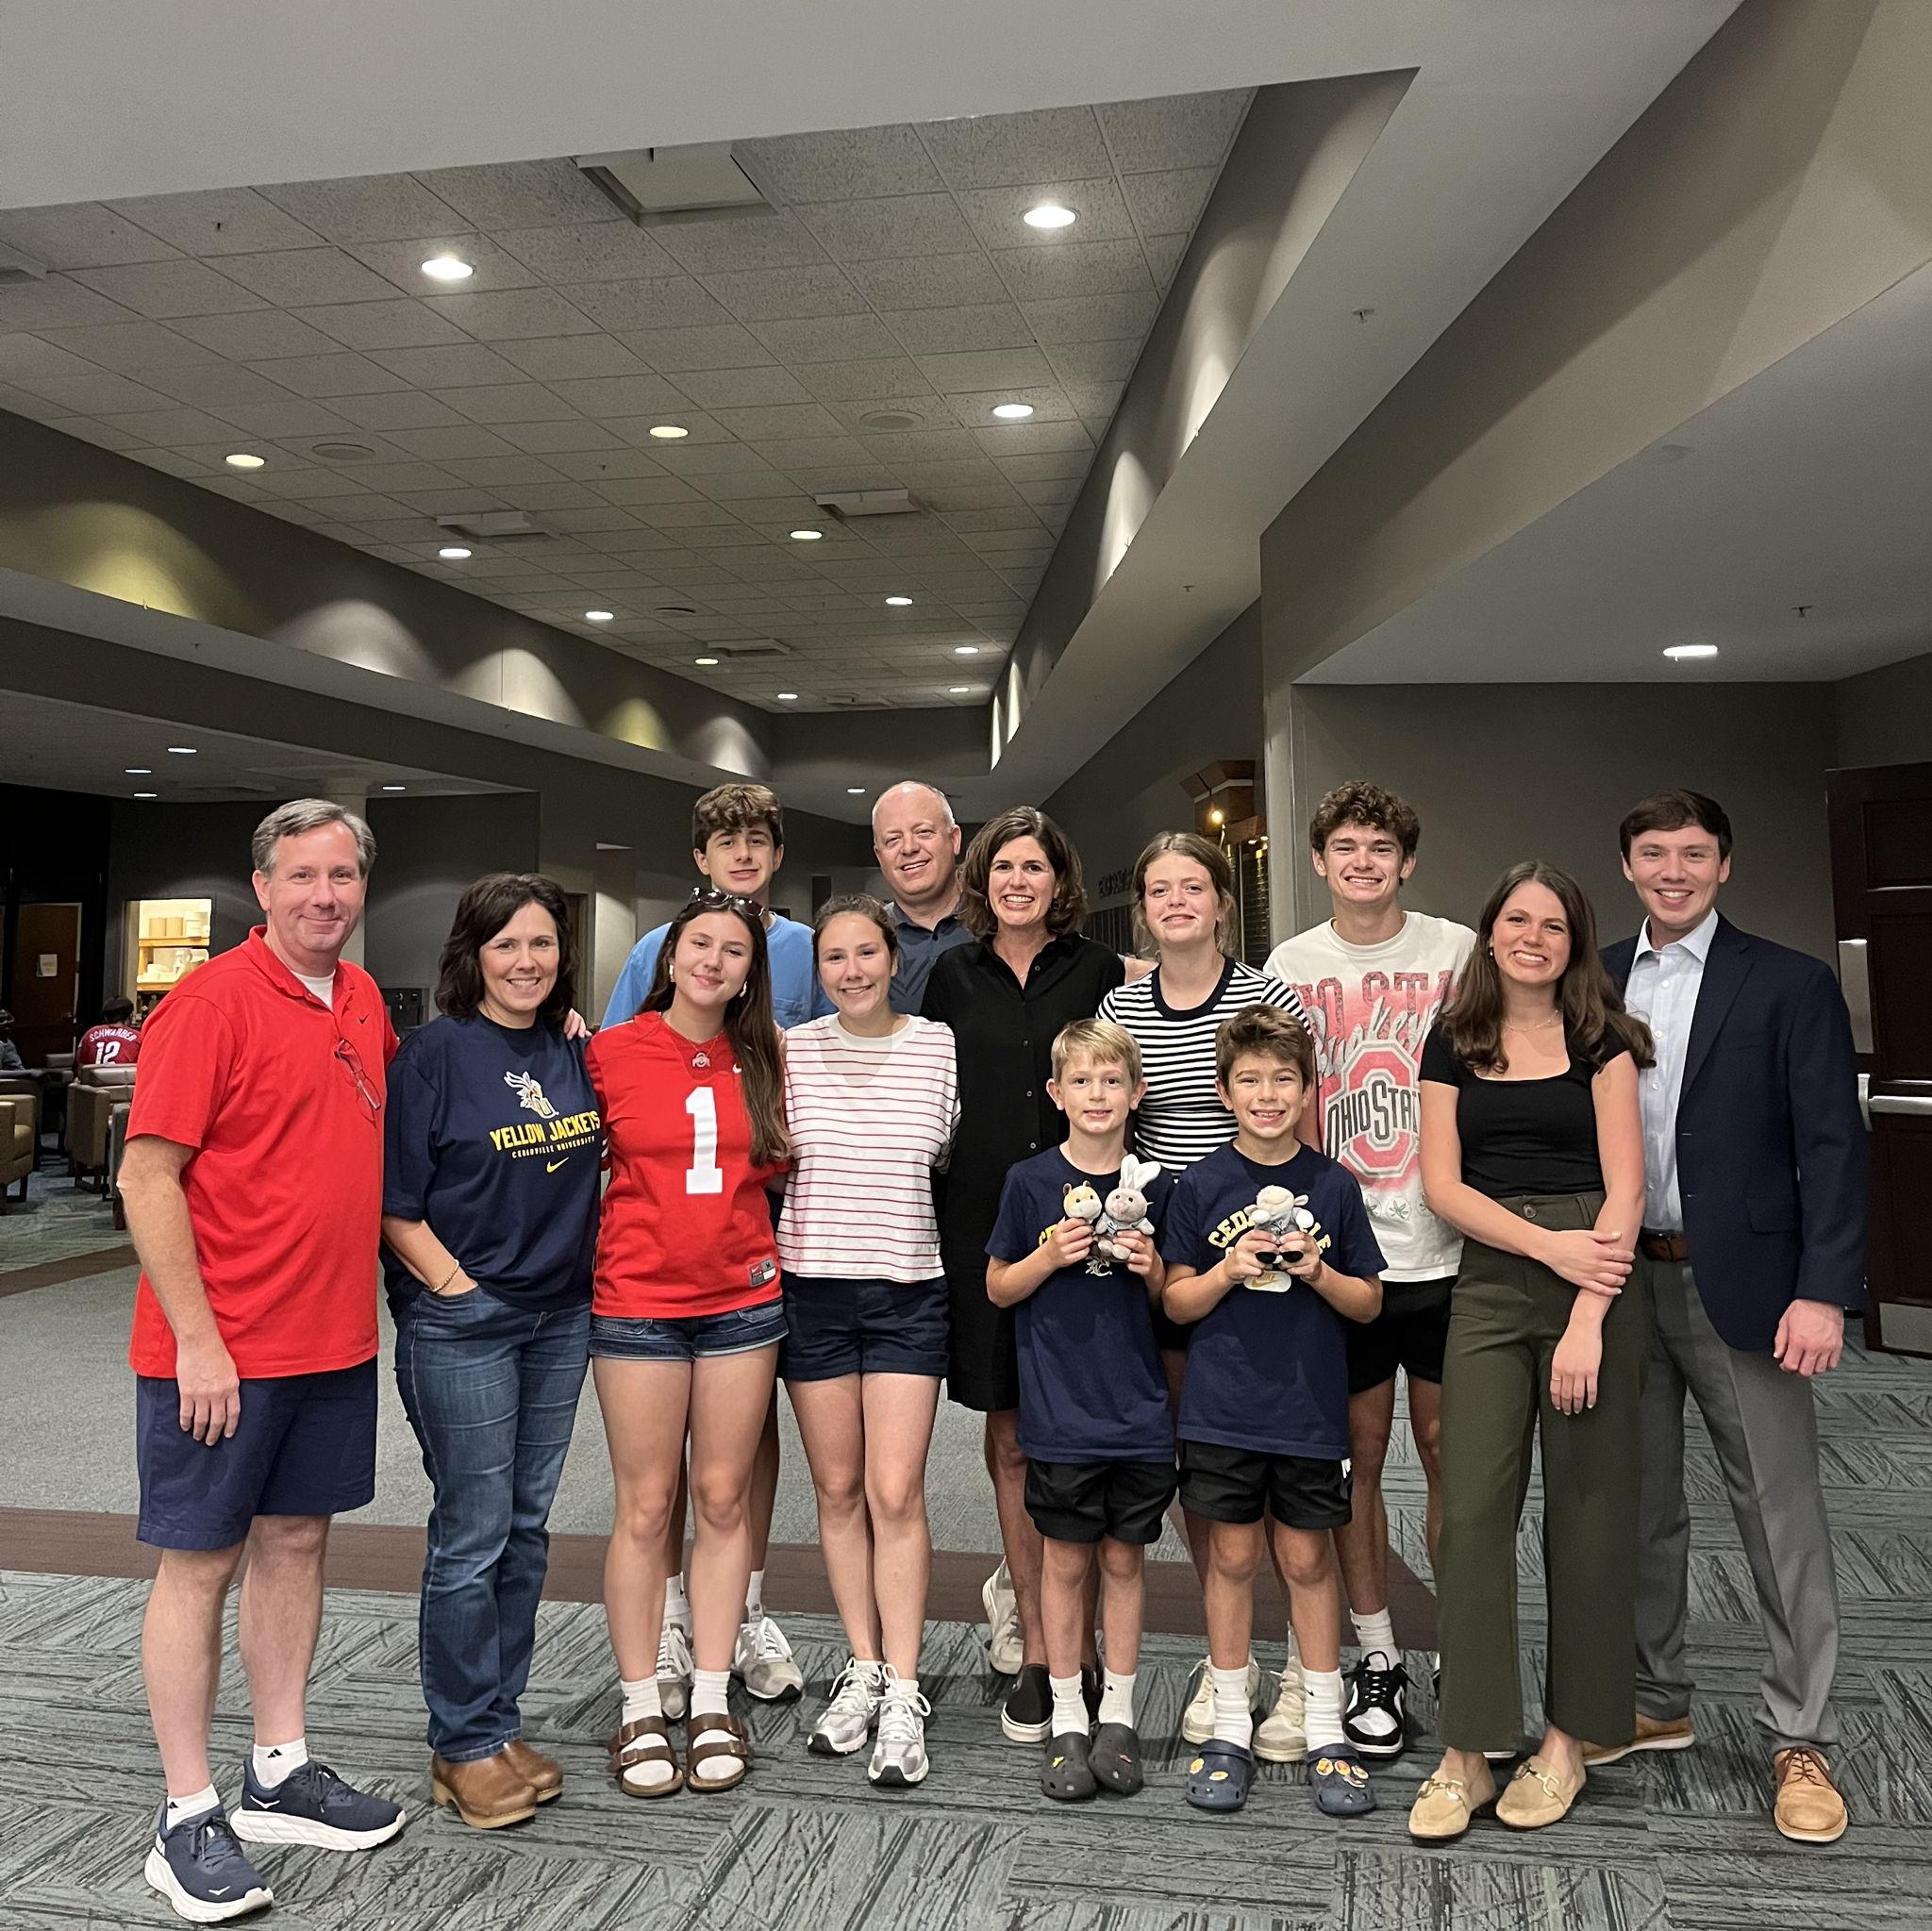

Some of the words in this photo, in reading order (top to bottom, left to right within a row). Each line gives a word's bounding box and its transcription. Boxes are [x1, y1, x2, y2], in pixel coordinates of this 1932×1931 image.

[89, 1028, 138, 1042] SCHWARBER
[95, 1040, 121, 1064] 12
[489, 1123, 546, 1151] YELLOW
[548, 1110, 601, 1141] JACKETS
[685, 1086, 723, 1194] 1
[1325, 1090, 1371, 1159] OHIO
[557, 1135, 595, 1152] UNIVERSITY
